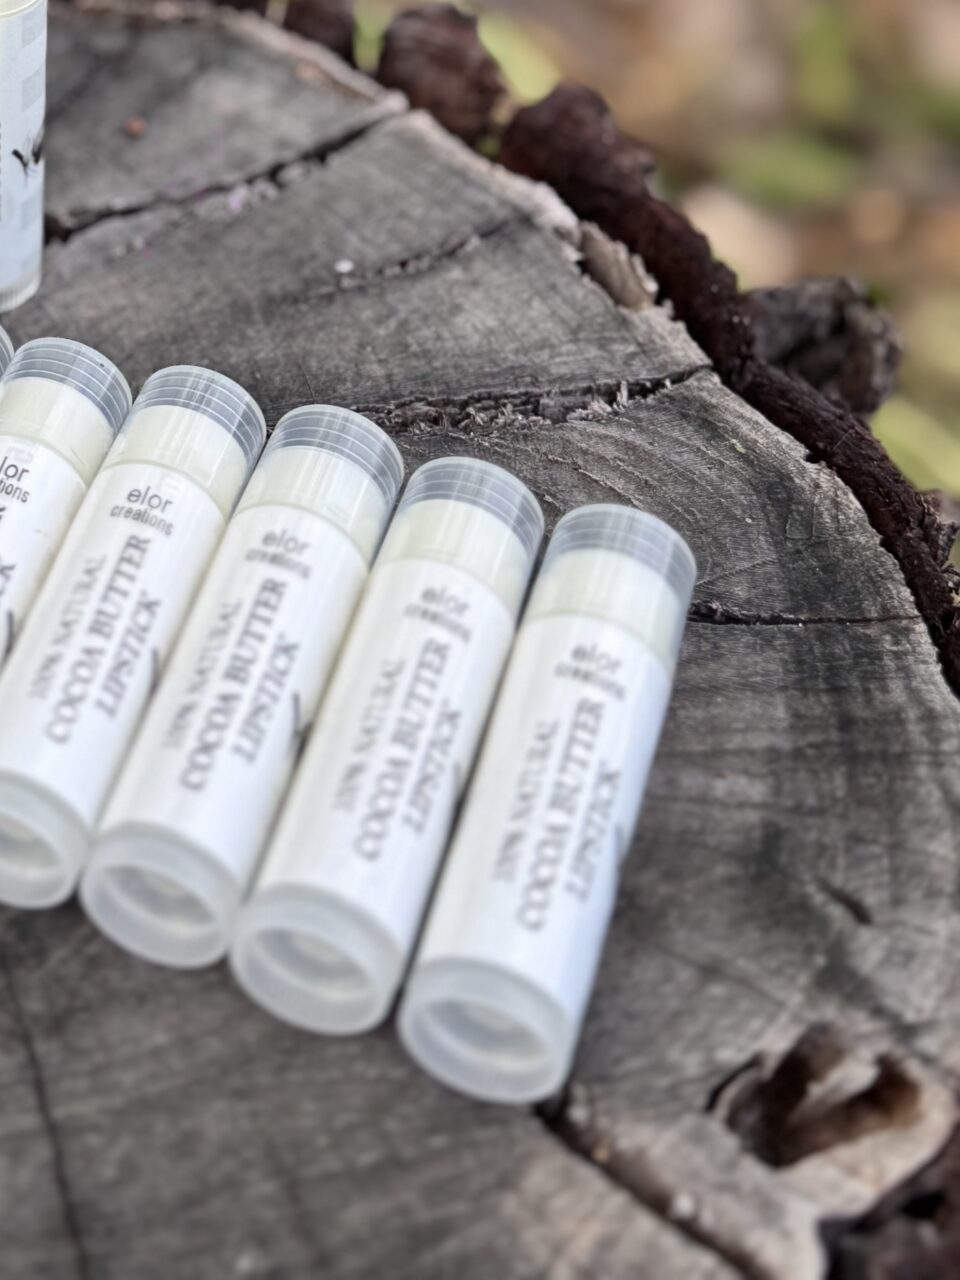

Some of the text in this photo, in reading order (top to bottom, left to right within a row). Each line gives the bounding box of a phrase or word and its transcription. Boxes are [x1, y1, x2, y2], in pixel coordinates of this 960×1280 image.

[109, 503, 174, 537] creations
[126, 486, 174, 514] elor
[44, 534, 152, 745] COCOA BUTTER
[94, 588, 161, 718] LIPSTICK
[179, 692, 242, 792] COCOA
[222, 577, 288, 684] BUTTER
[231, 632, 301, 765] LIPSTICK
